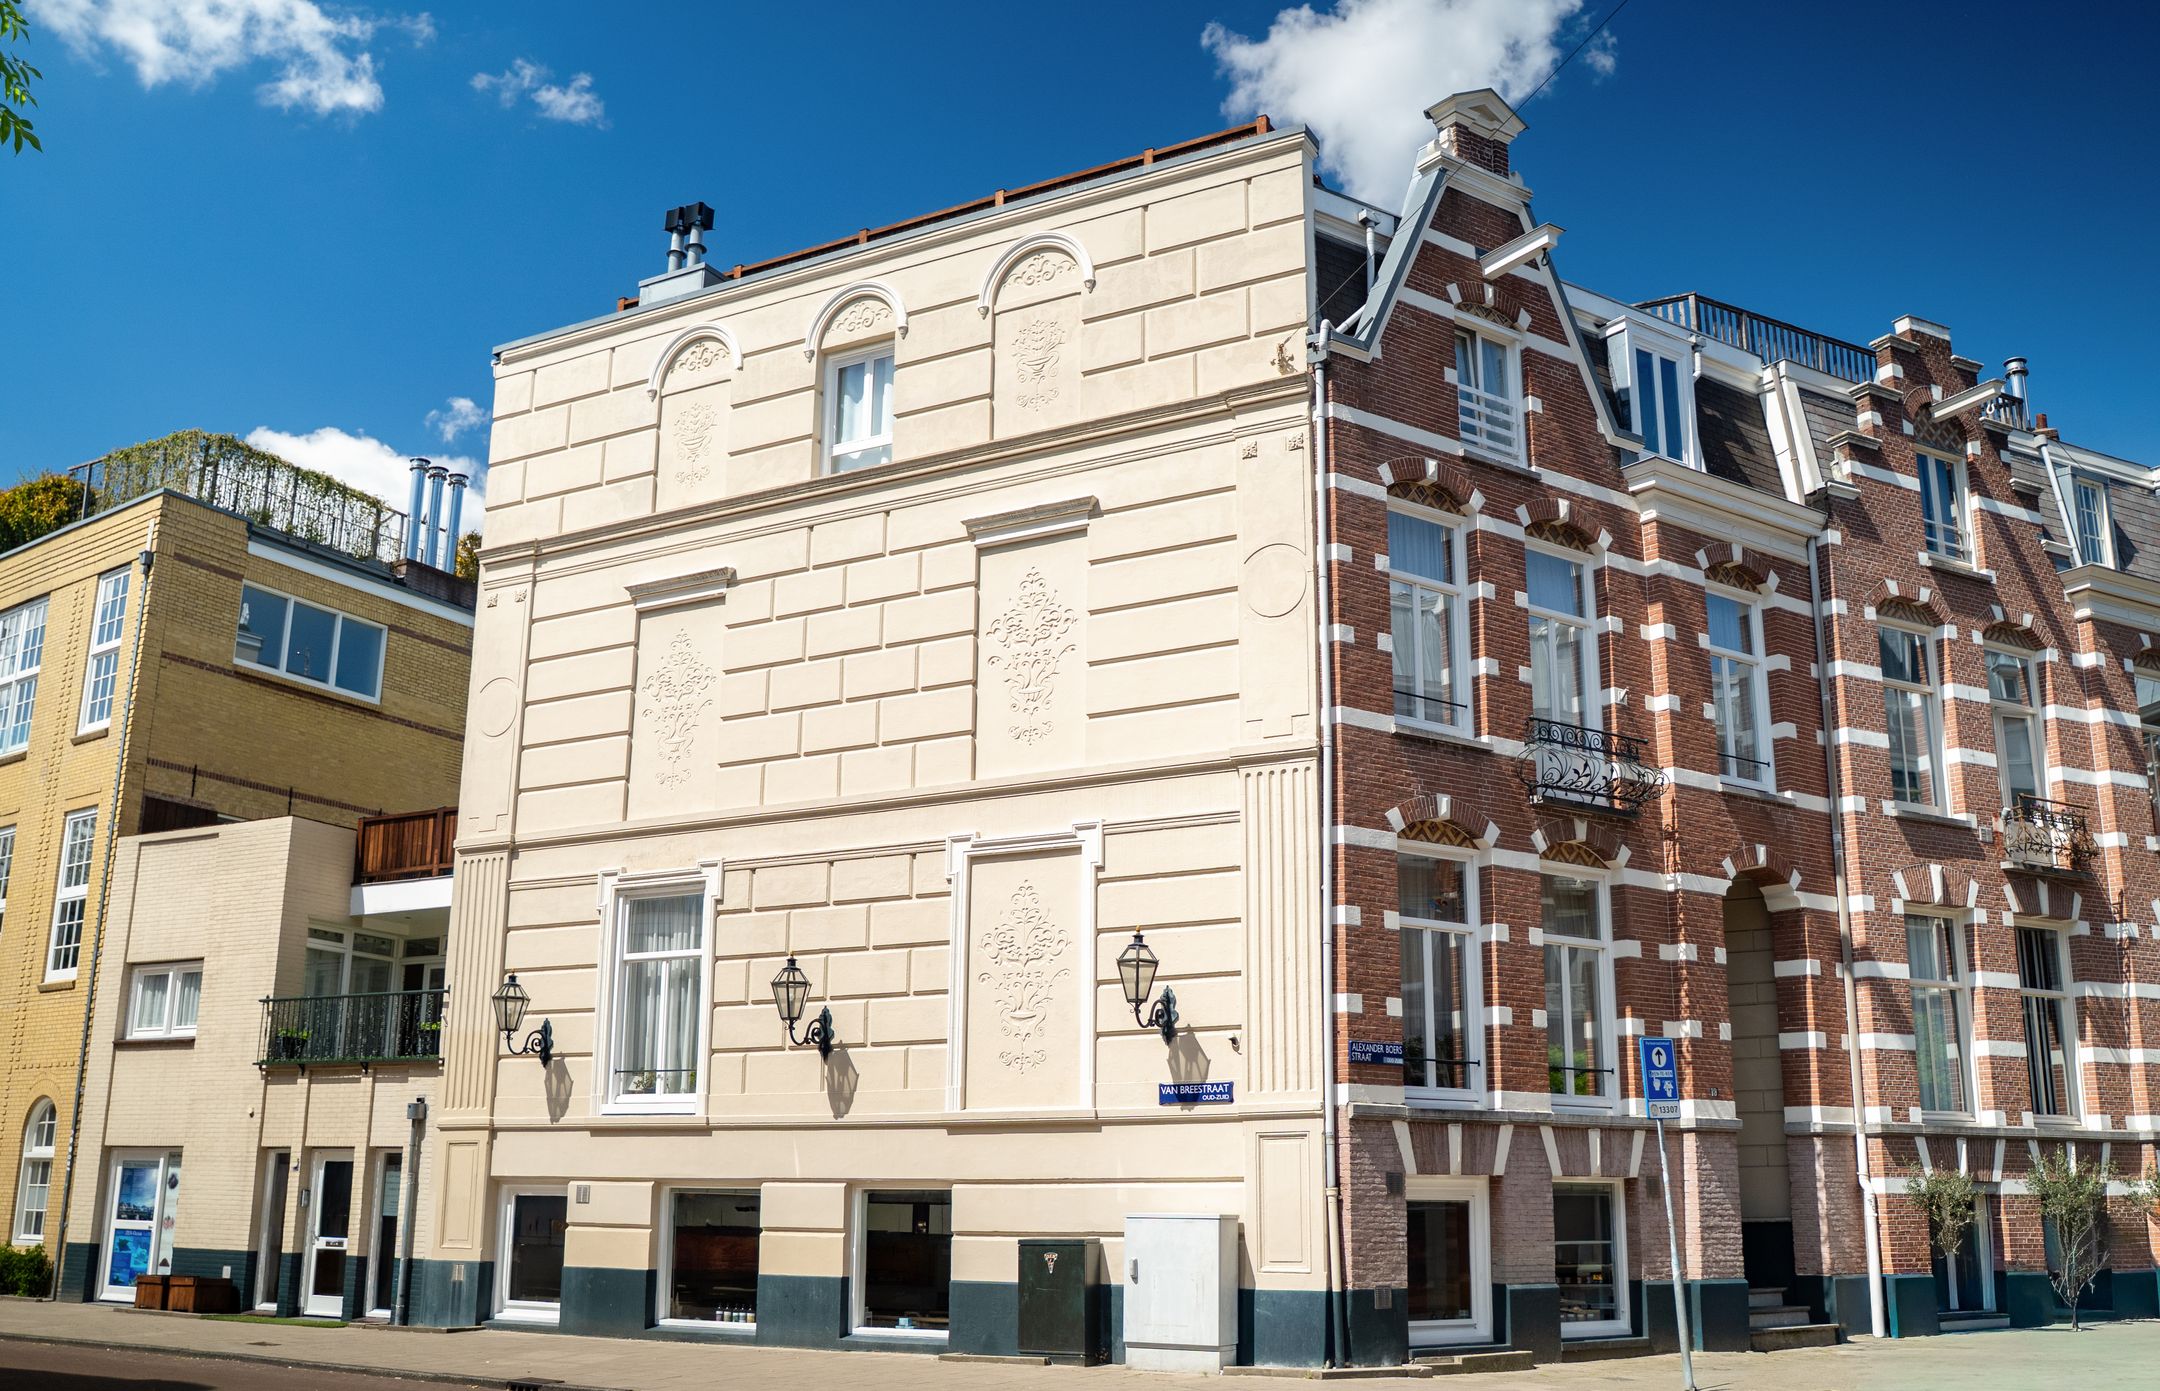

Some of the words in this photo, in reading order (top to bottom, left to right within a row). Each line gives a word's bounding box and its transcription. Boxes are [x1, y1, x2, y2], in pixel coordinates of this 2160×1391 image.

[1352, 1042, 1384, 1053] ALEXANDER
[1386, 1045, 1403, 1055] BOERS
[1351, 1052, 1372, 1062] STRAAT
[1160, 1086, 1178, 1095] VAN
[1180, 1084, 1230, 1094] BREESTRAAT
[1659, 1105, 1678, 1114] 13307
